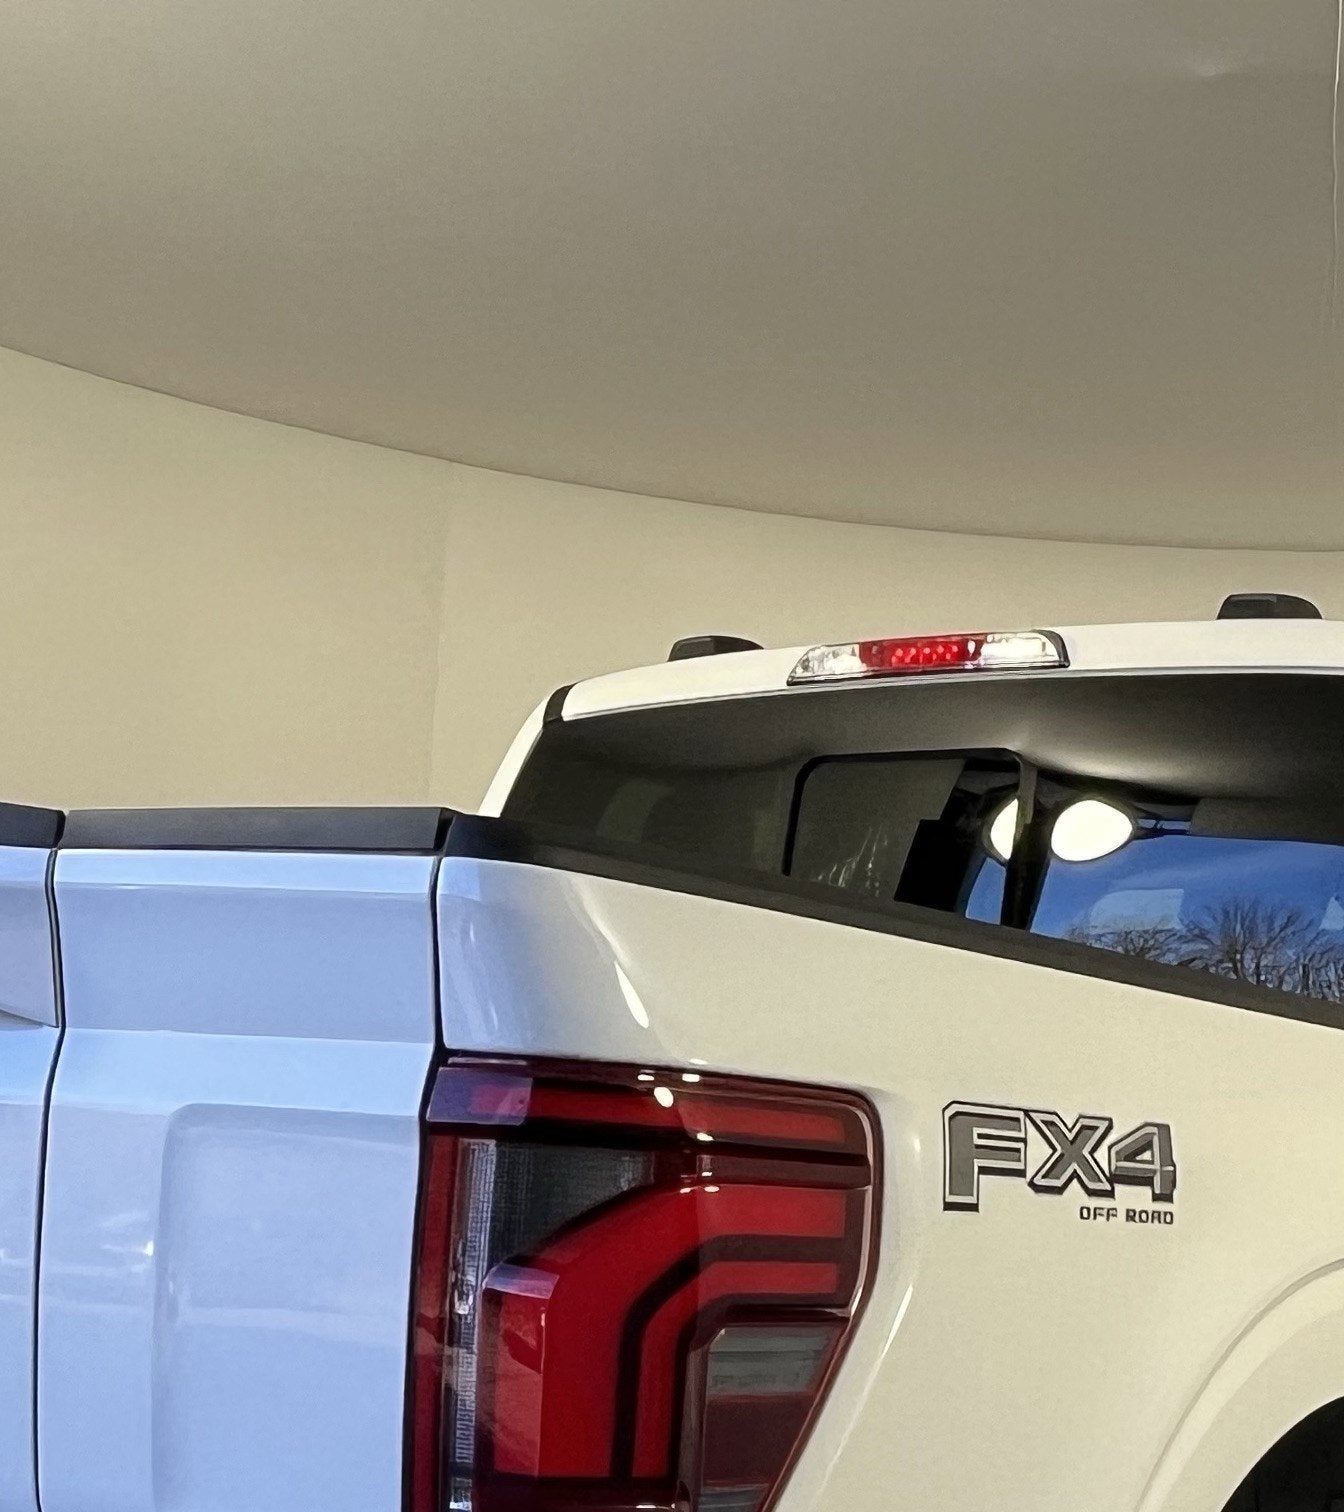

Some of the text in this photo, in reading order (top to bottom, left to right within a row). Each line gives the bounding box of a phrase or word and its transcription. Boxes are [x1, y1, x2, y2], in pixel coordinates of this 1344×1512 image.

[942, 1100, 1176, 1212] FX4
[1079, 1205, 1175, 1226] OFF ROAD
